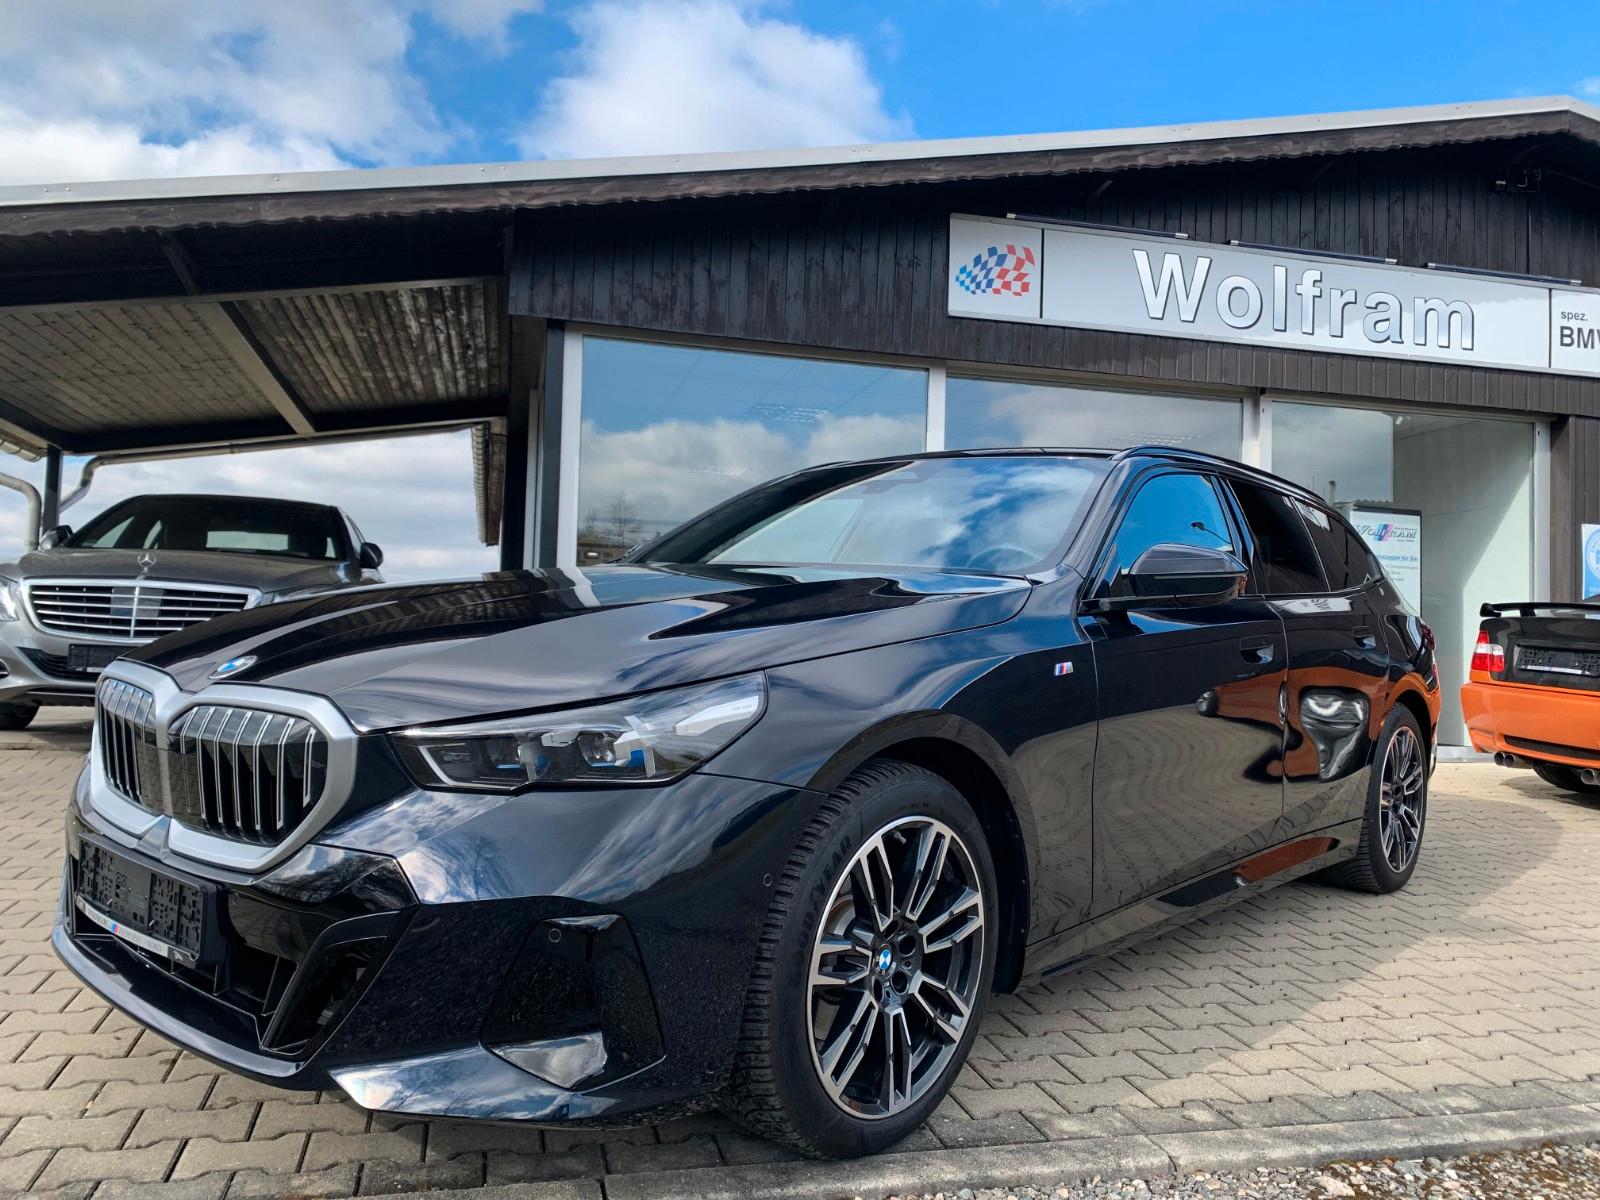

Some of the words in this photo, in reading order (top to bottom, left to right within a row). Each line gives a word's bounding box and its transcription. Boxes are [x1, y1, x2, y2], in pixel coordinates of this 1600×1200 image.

[1132, 249, 1475, 351] Wolfram
[1560, 311, 1588, 322] spez.
[1560, 325, 1600, 349] BM
